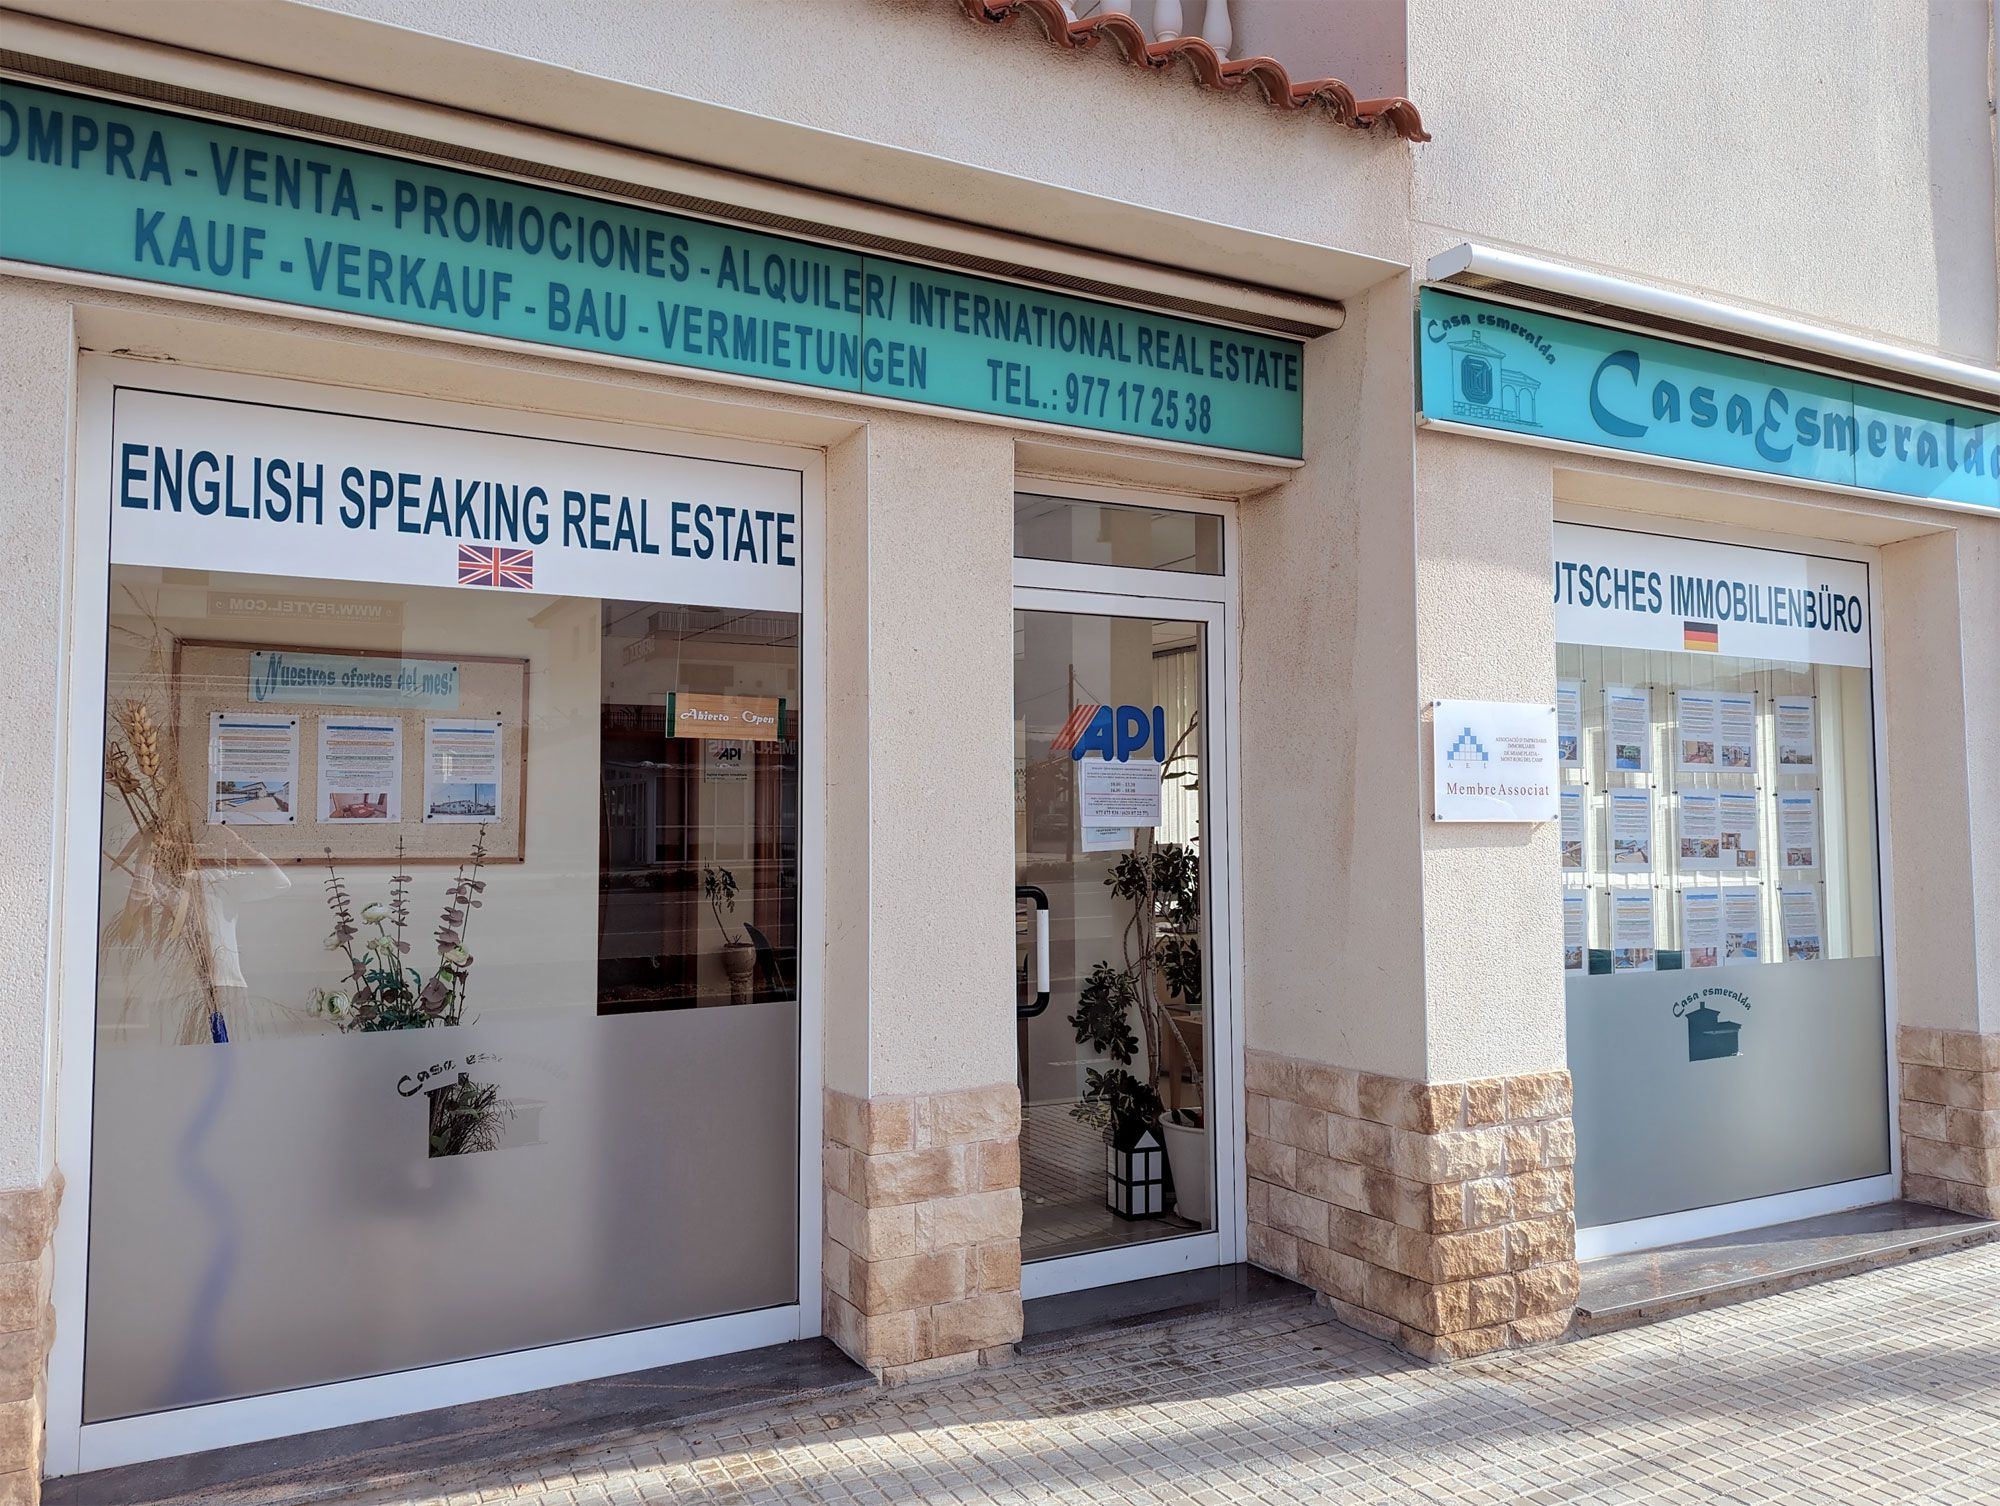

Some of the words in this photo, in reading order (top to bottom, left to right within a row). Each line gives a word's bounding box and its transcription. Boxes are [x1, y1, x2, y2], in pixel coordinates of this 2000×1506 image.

[209, 142, 361, 221] VENTA
[394, 178, 690, 283] PROMOCIONES
[909, 281, 1132, 364] INTERNATIONAL
[1136, 326, 1204, 375] REAL
[1210, 338, 1298, 392] ESTATE
[134, 207, 267, 280] KAUF
[304, 236, 513, 321] VERKAUF
[548, 281, 628, 342] BAU
[658, 300, 928, 390] VERMIETUNGEN
[1427, 314, 1472, 344] Casa
[1478, 313, 1556, 365] esmeralda
[1065, 372, 1110, 418] 977
[1117, 377, 1143, 422] 17
[1150, 385, 1180, 428] 25
[1184, 391, 1212, 435] 38
[120, 442, 325, 527] ENGLISH
[339, 466, 550, 546] SPEAKING
[563, 489, 660, 555] REAL
[671, 500, 797, 567] ESTATE
[1670, 574, 1862, 634] IMMOBILIENBÜRO
[256, 652, 335, 702] Nuestras
[341, 667, 393, 690] ofertas
[397, 667, 418, 692] del
[680, 708, 730, 722] Abierto
[741, 710, 775, 726] Open
[1071, 705, 1165, 763] API
[718, 747, 742, 761] API
[1672, 992, 1700, 1018] Casa
[1702, 987, 1752, 1011] esmeralda
